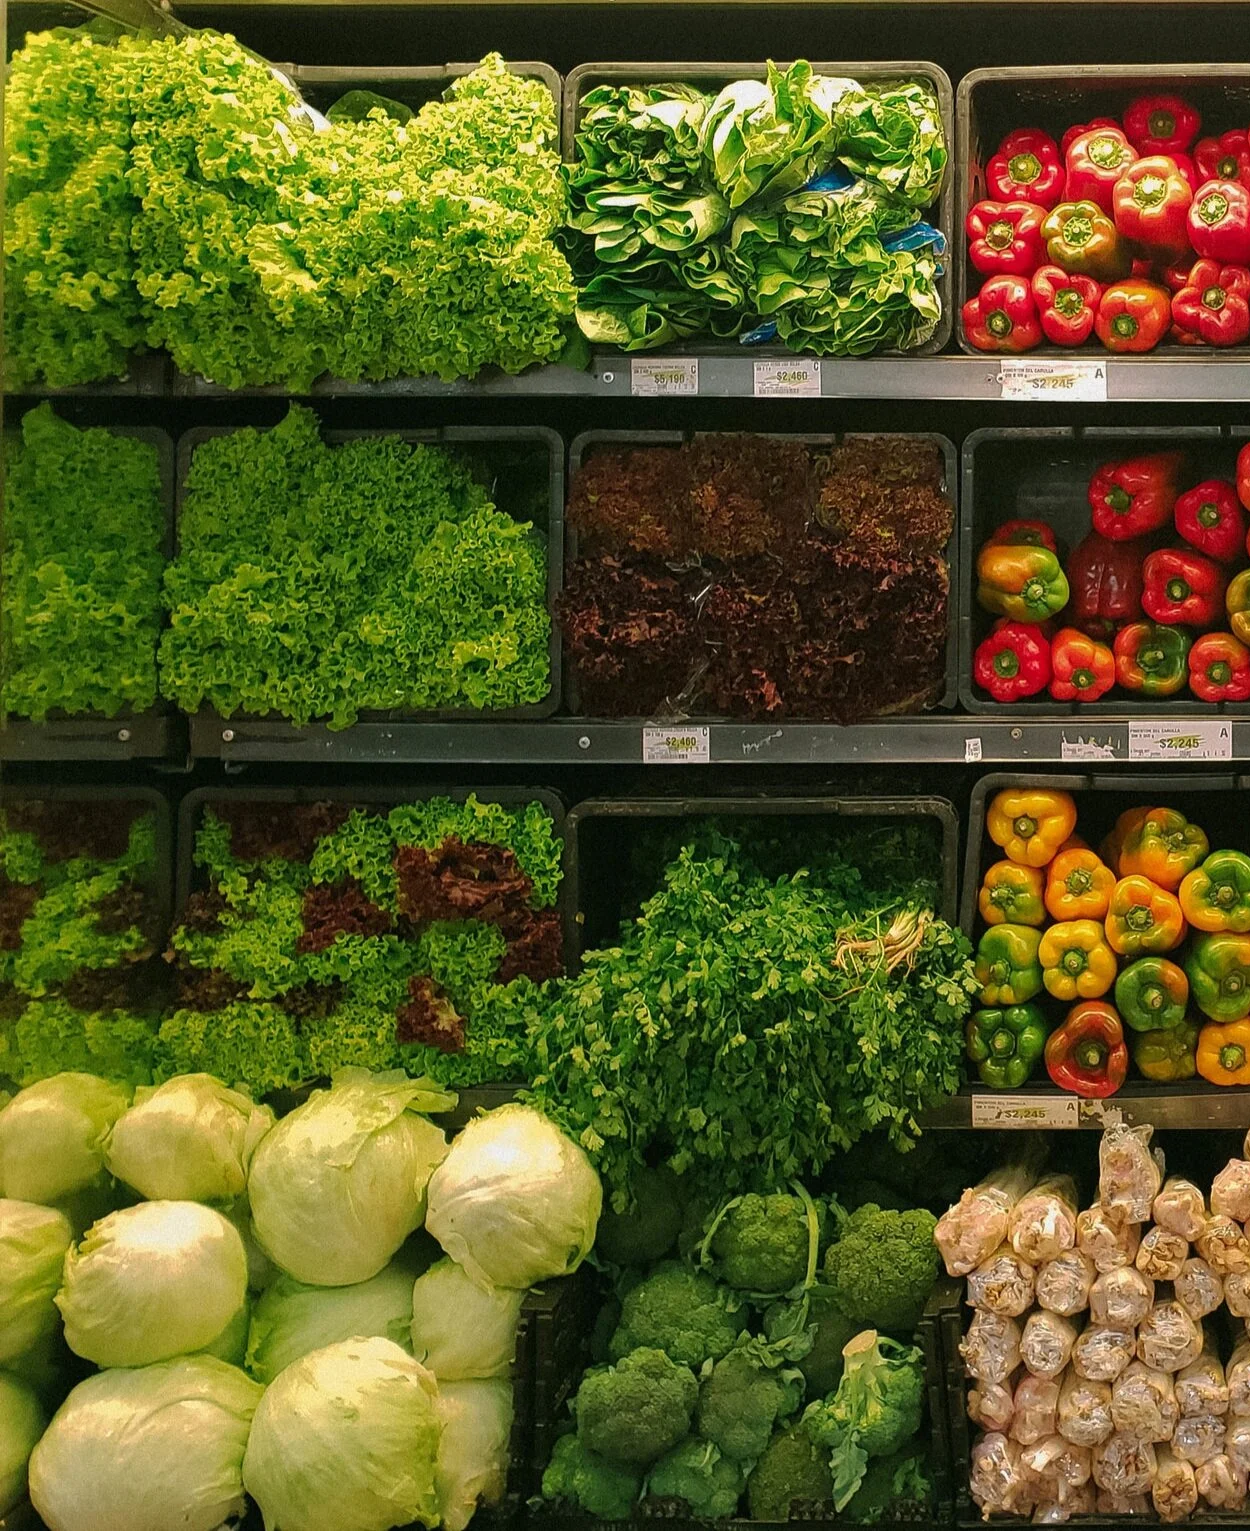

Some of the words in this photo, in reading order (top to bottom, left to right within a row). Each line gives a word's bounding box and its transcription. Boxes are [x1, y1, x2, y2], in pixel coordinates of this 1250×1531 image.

[690, 365, 697, 374] C
[813, 361, 819, 371] C
[776, 371, 808, 382] $2,460
[1095, 368, 1104, 379] A
[702, 727, 708, 737] C
[1219, 728, 1229, 738] A
[1159, 738, 1200, 750] $2,245
[1066, 1102, 1075, 1111] A
[1004, 1110, 1046, 1119] $2,245
